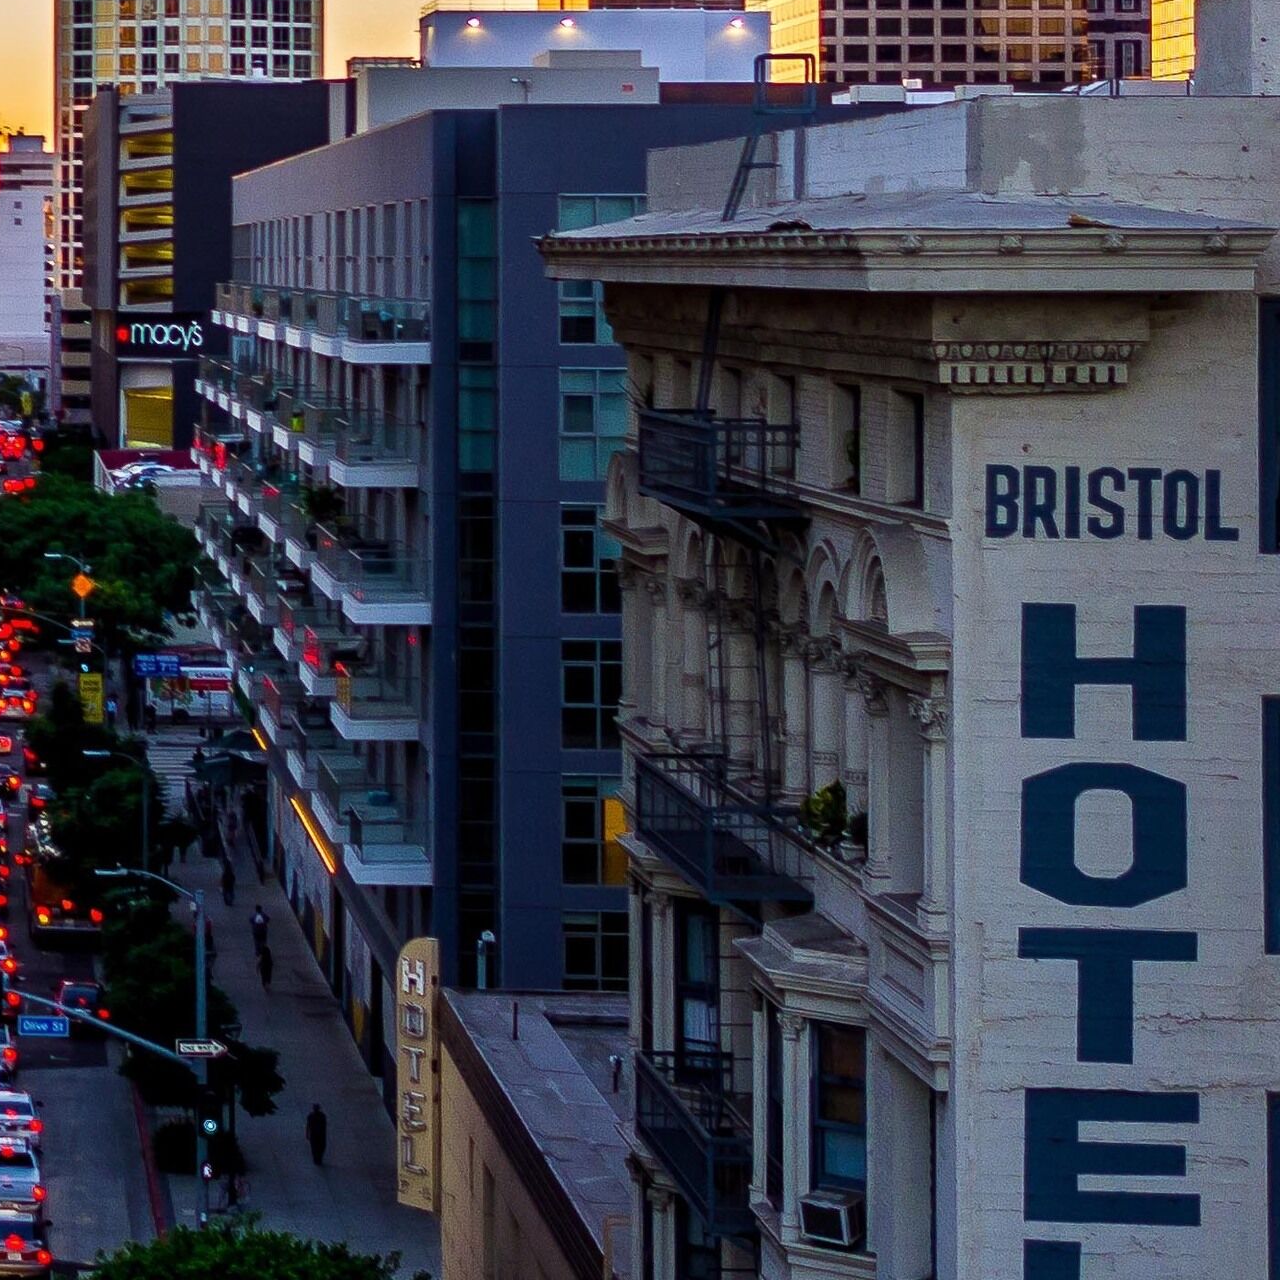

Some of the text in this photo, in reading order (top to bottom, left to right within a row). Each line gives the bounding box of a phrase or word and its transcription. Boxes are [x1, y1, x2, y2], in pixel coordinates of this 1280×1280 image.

[130, 320, 203, 351] macy's
[984, 464, 1240, 542] BRISTOL
[1018, 602, 1202, 1280] HOTE
[23, 1019, 64, 1031] Olive St
[400, 956, 426, 1176] HOTEL
